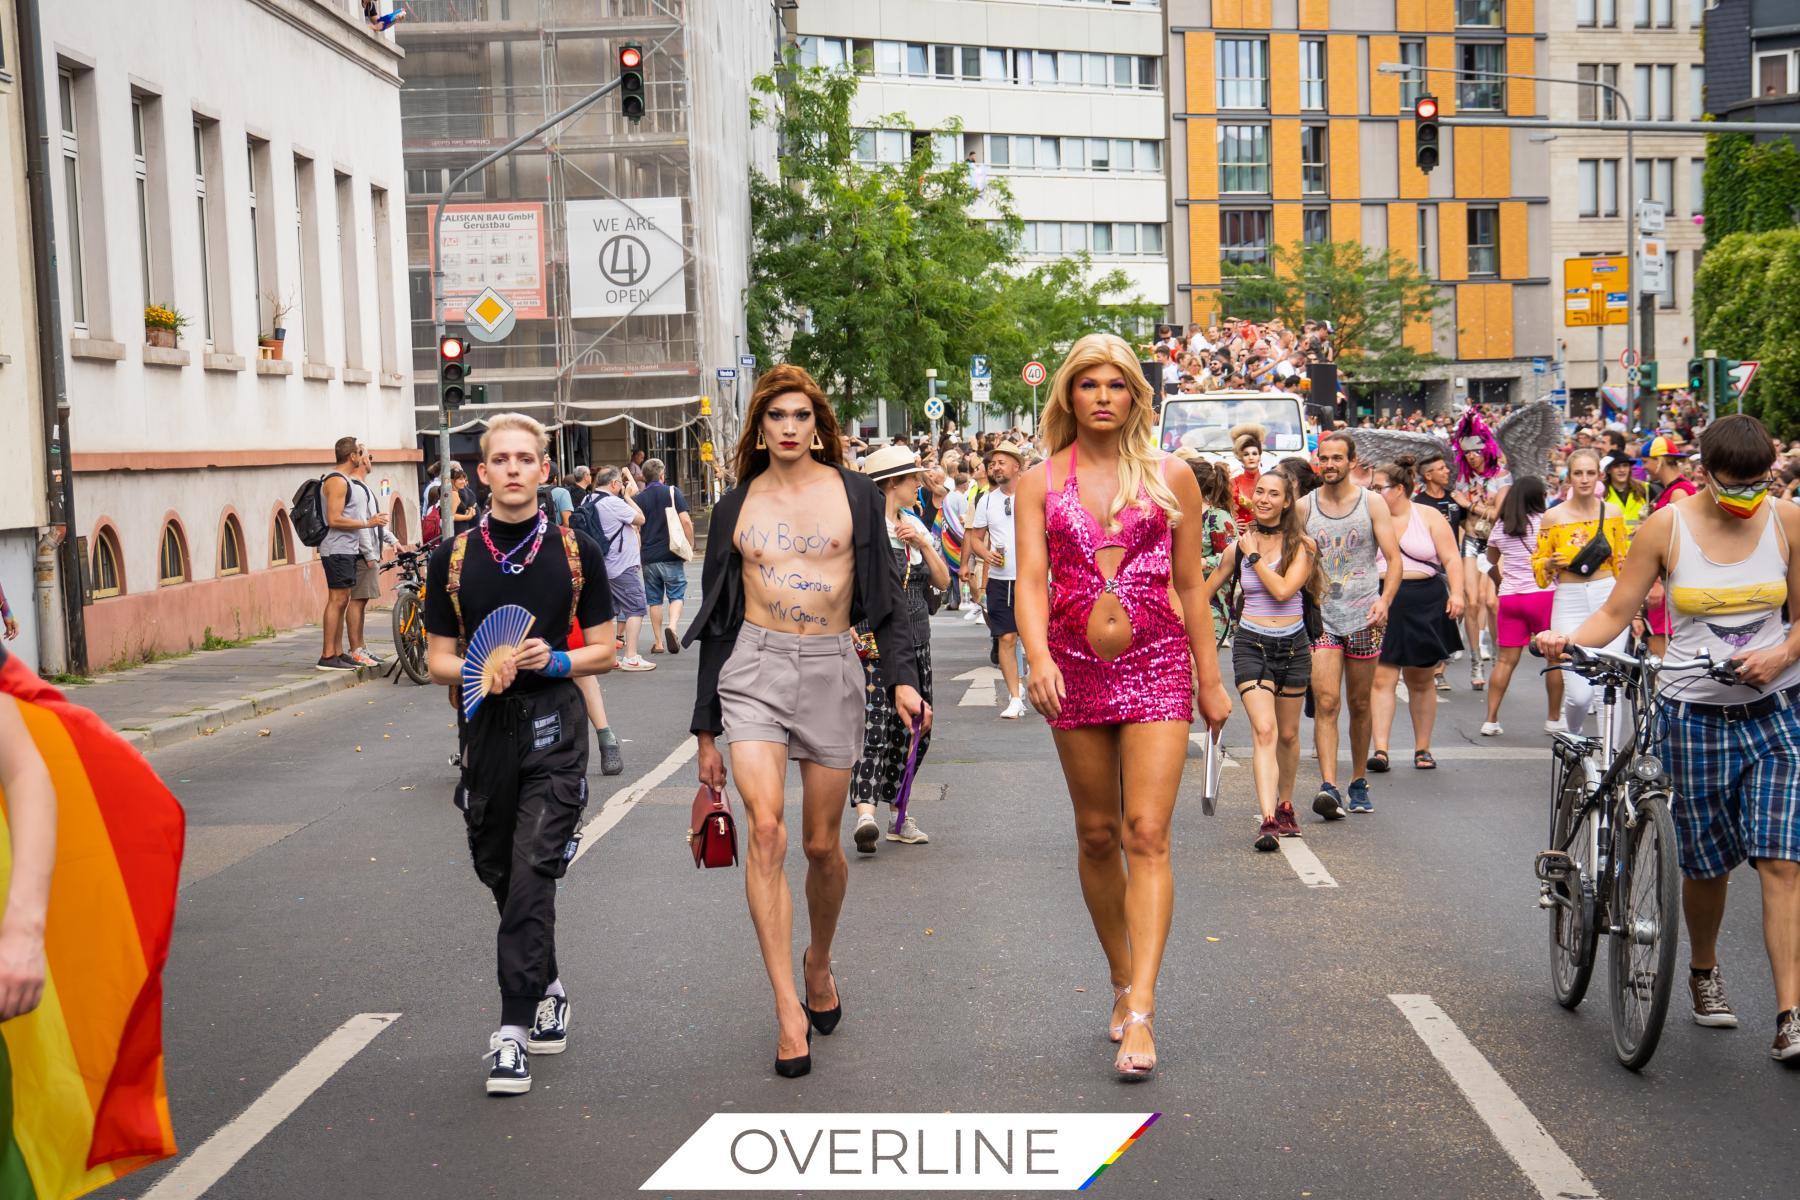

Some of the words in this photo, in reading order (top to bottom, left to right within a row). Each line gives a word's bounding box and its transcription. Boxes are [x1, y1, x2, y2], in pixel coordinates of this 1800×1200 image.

[486, 213, 505, 221] BAU
[507, 213, 534, 221] GmbH
[593, 218, 620, 232] WE
[624, 217, 656, 231] ARE
[608, 236, 639, 285] 4
[605, 288, 650, 304] OPEN
[1028, 368, 1041, 379] 40
[739, 524, 770, 552] My
[777, 523, 831, 557] Body
[759, 564, 787, 588] My
[788, 573, 832, 593] Gender
[768, 600, 787, 622] My
[790, 605, 828, 626] Choice
